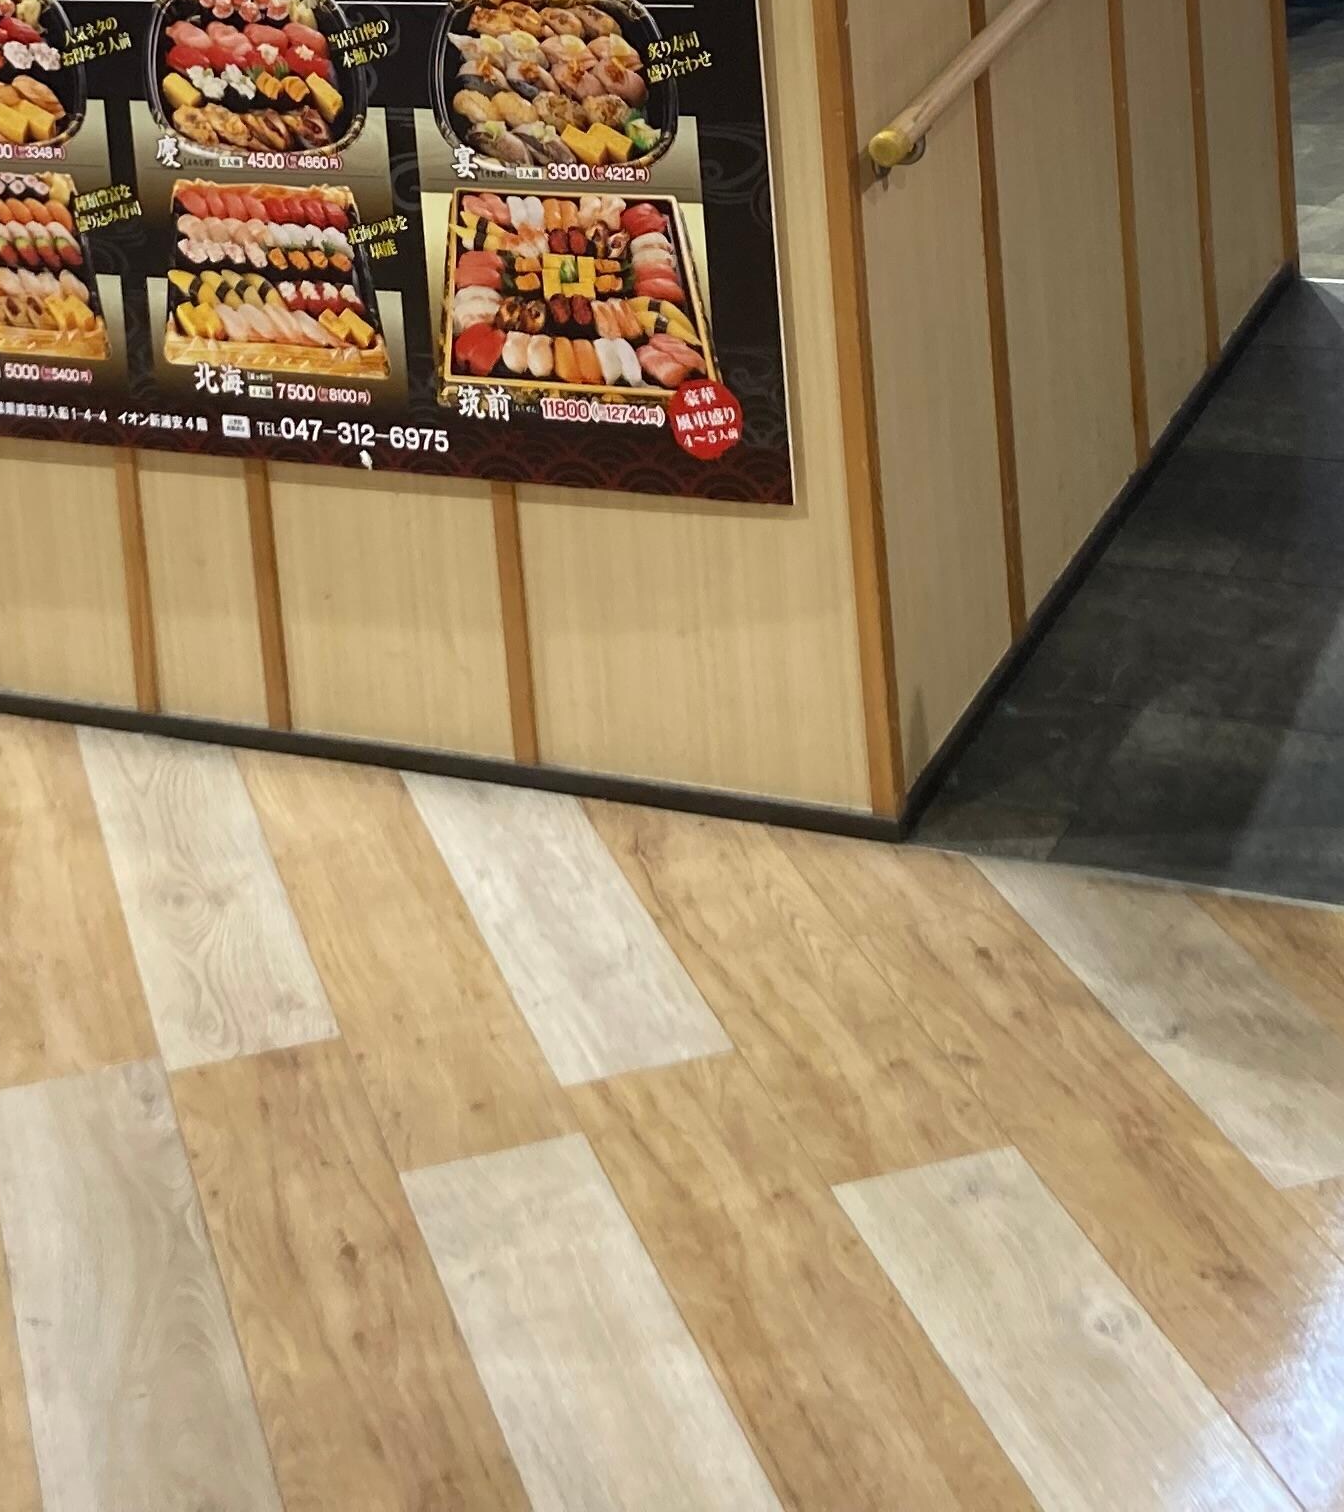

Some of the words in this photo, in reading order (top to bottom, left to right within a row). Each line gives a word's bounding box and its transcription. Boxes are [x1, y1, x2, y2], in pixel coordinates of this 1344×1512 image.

[64, 17, 118, 47] 人気ネタの
[646, 50, 713, 85] 盛り合わせ
[452, 144, 476, 180] 宴
[193, 363, 245, 397] 北海
[457, 385, 512, 421] 筑前
